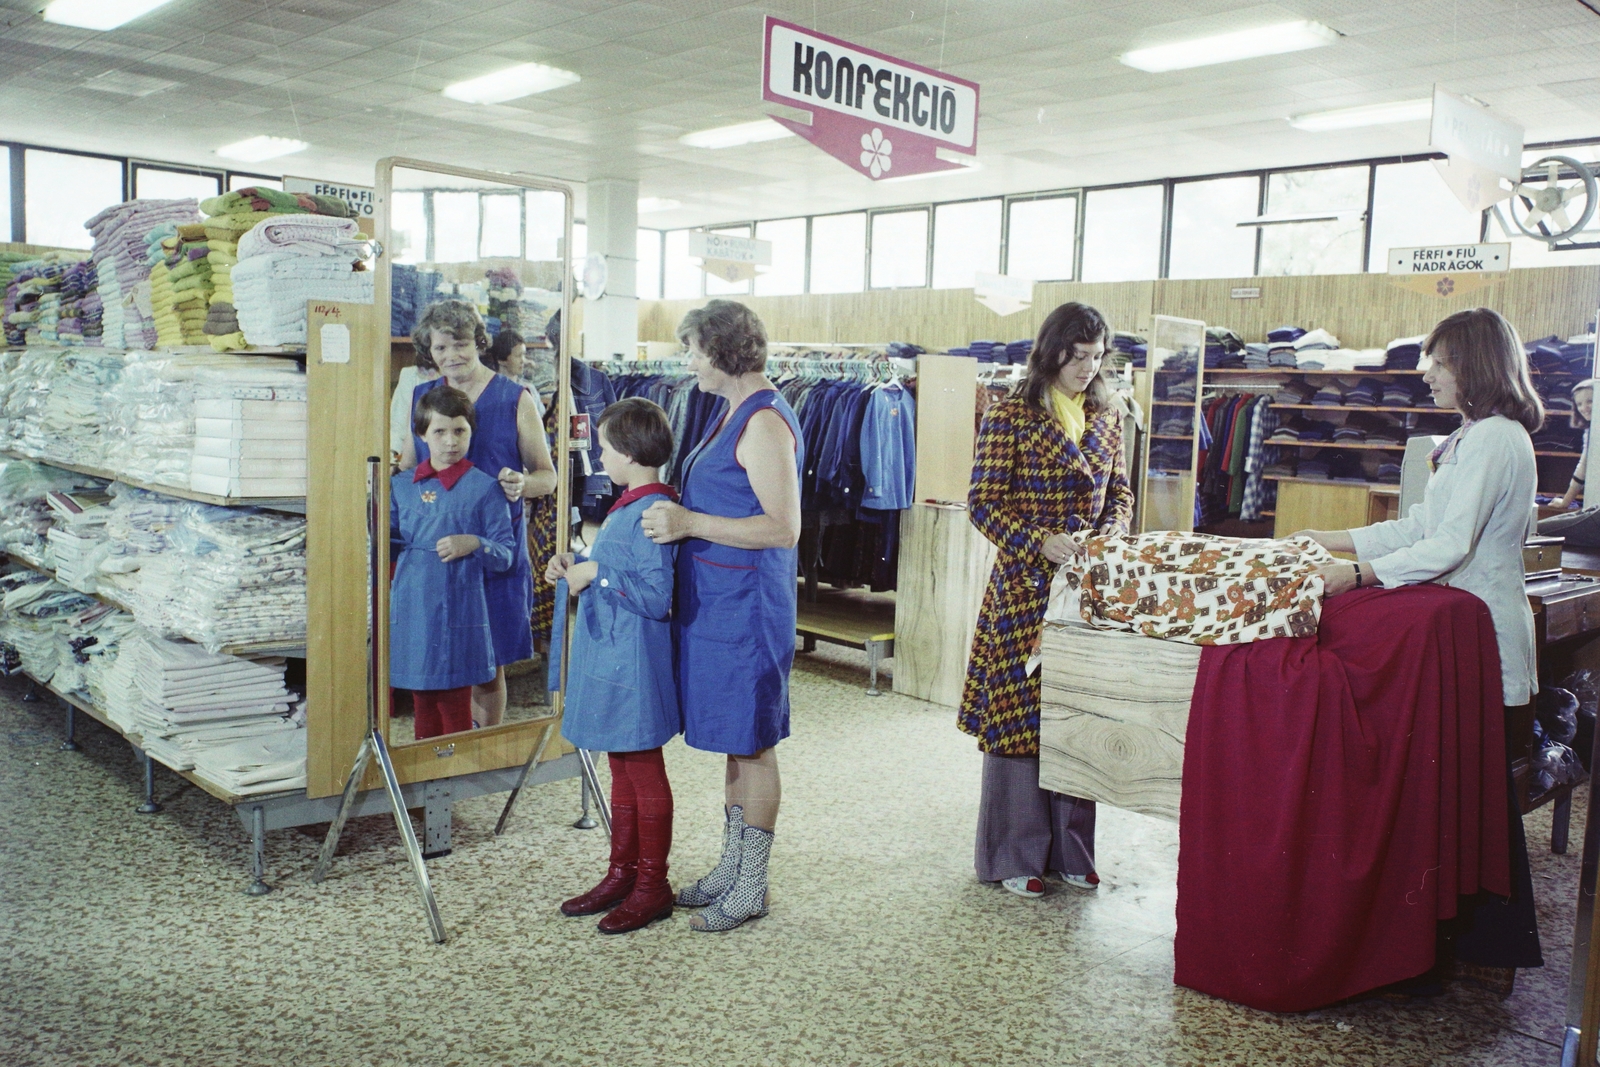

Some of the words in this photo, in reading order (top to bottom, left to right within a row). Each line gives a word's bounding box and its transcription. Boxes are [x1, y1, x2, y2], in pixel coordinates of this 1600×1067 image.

[792, 41, 956, 134] KONFEKCIÓ
[315, 184, 350, 200] FÉRFI
[360, 191, 375, 203] FI
[1413, 248, 1443, 260] FÉRFI
[1456, 246, 1476, 258] FIÚ
[1413, 260, 1483, 272] NADRÁGOK
